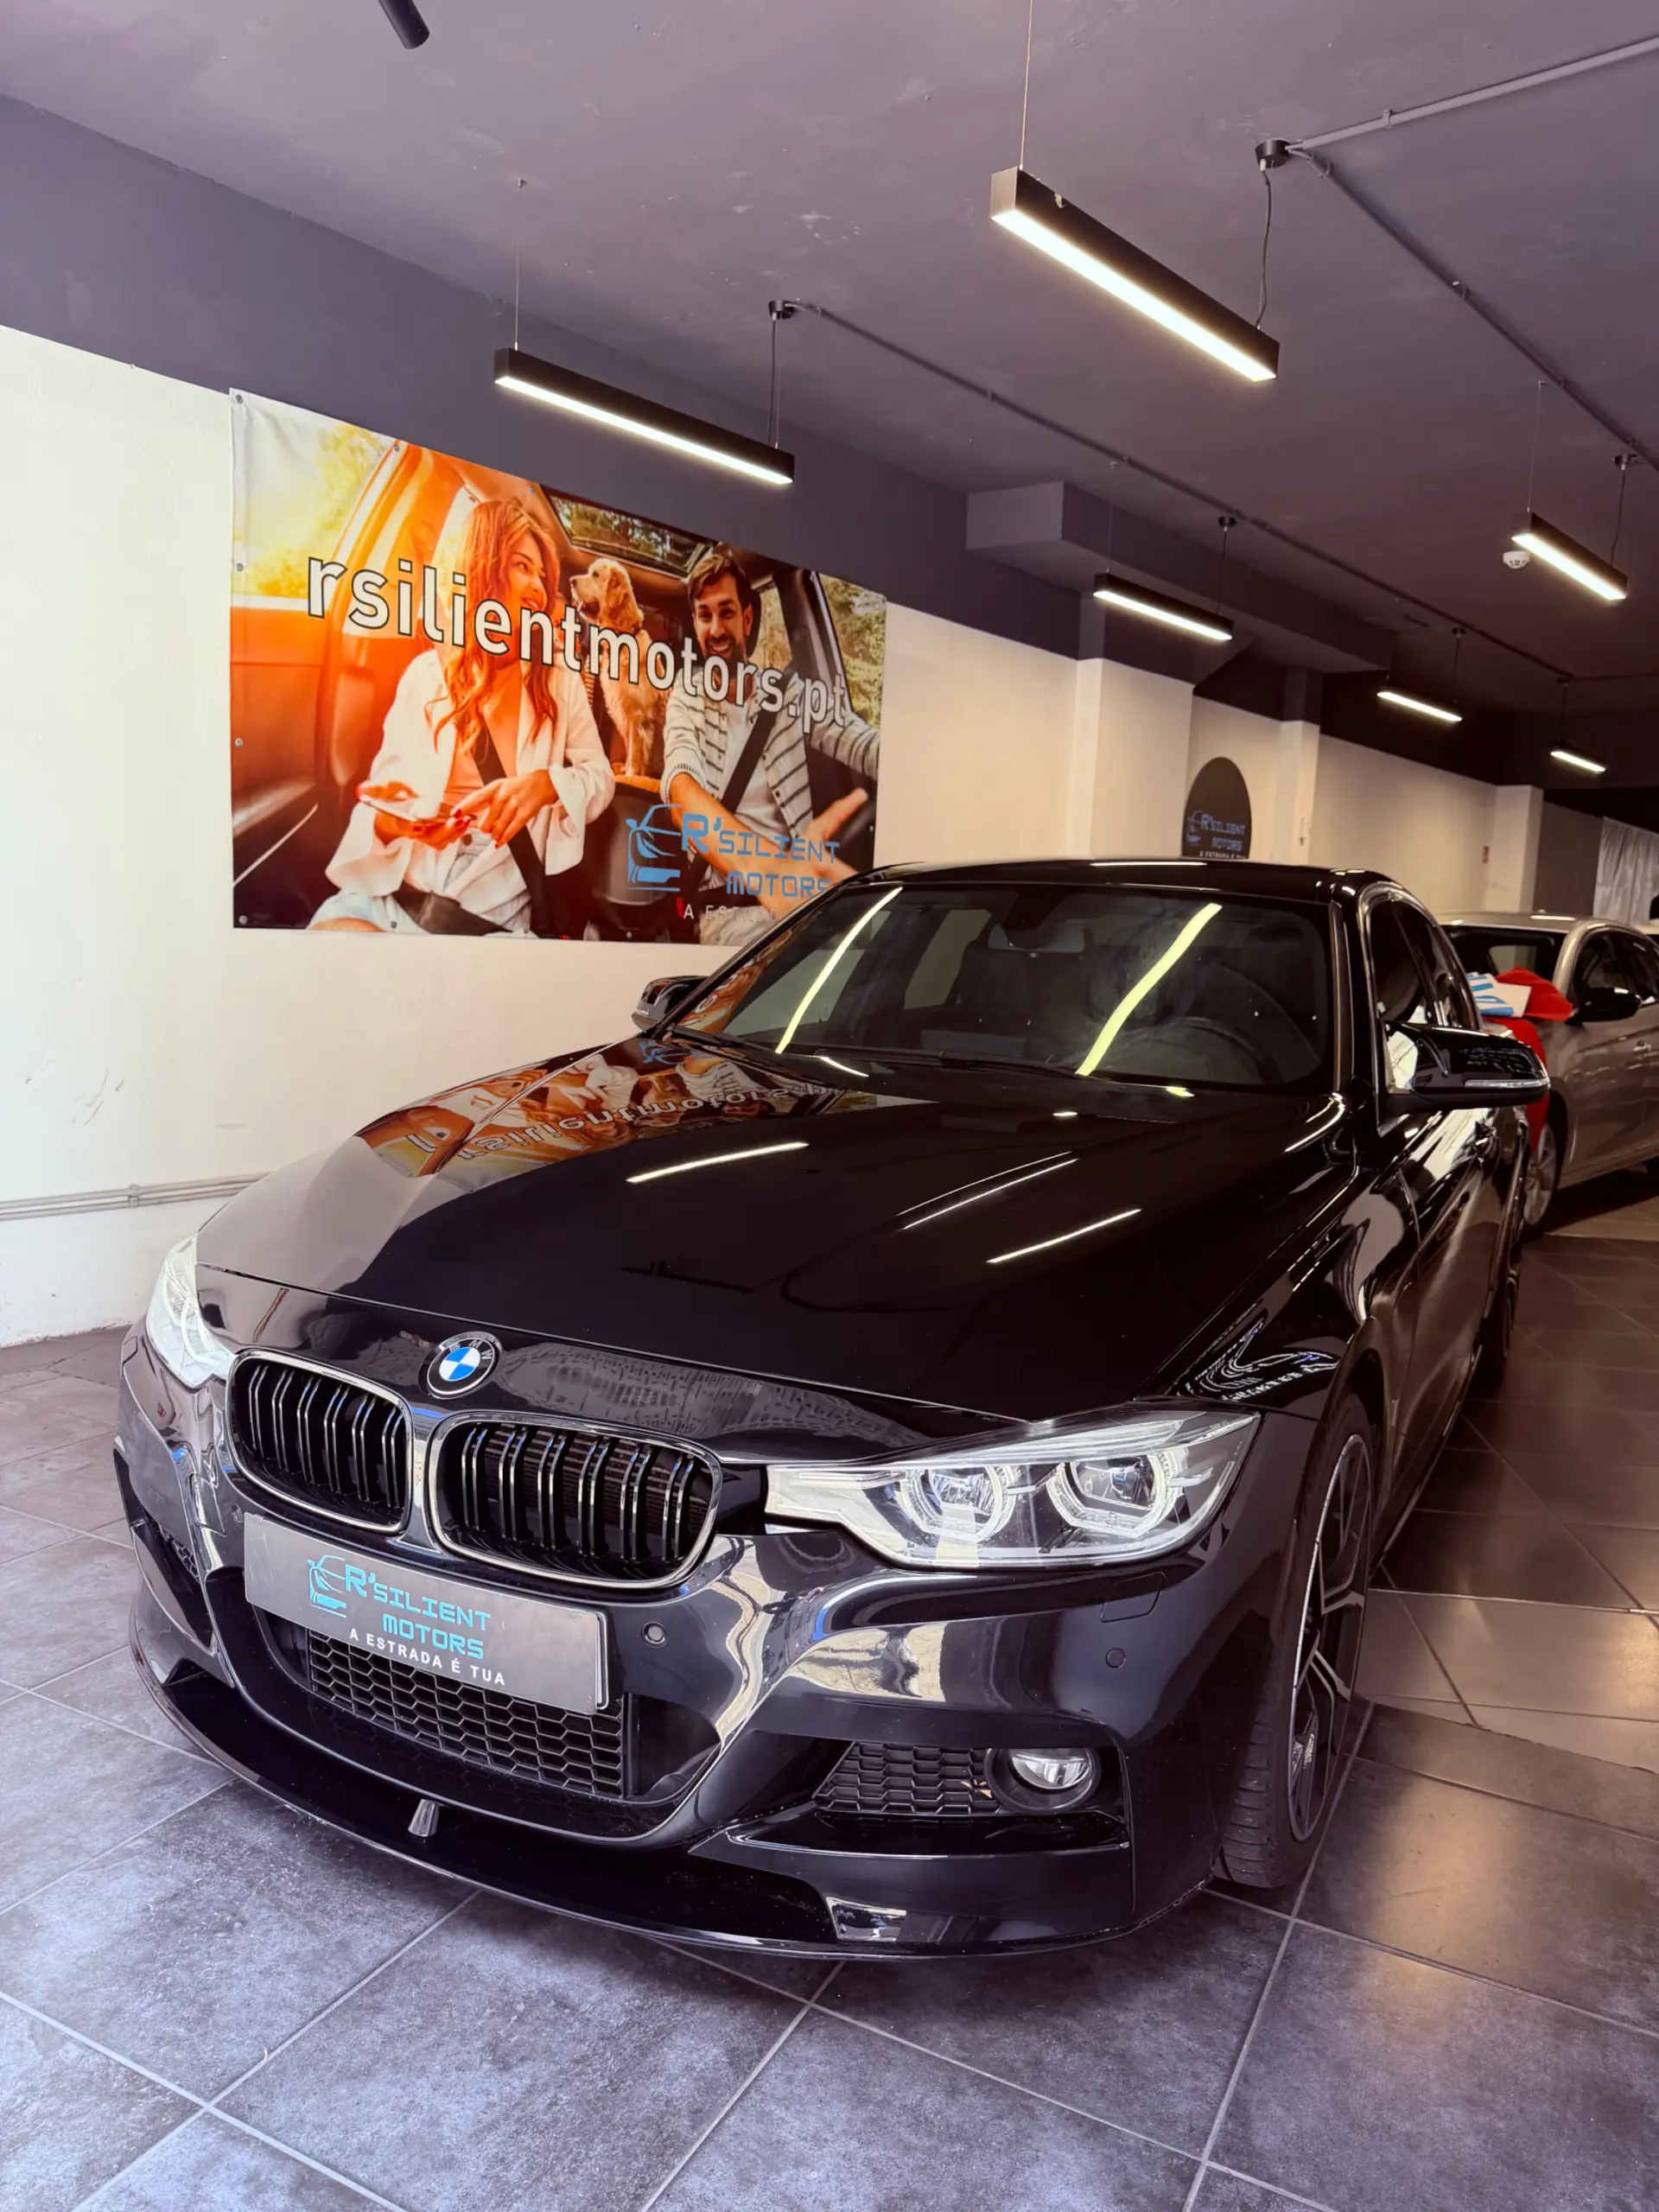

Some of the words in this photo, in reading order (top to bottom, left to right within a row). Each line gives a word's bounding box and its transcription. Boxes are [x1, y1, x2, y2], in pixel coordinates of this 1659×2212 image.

[307, 556, 846, 734] rsilientmotors.pt
[681, 812, 841, 863] R'SILIENT
[448, 1338, 493, 1359] BMW
[345, 1563, 492, 1630] R'SILIENT
[350, 1628, 359, 1641] A
[366, 1633, 443, 1669] ESTRADA
[452, 1658, 461, 1674] É
[471, 1665, 505, 1686] TUA
[383, 1614, 484, 1660] MOTORS
